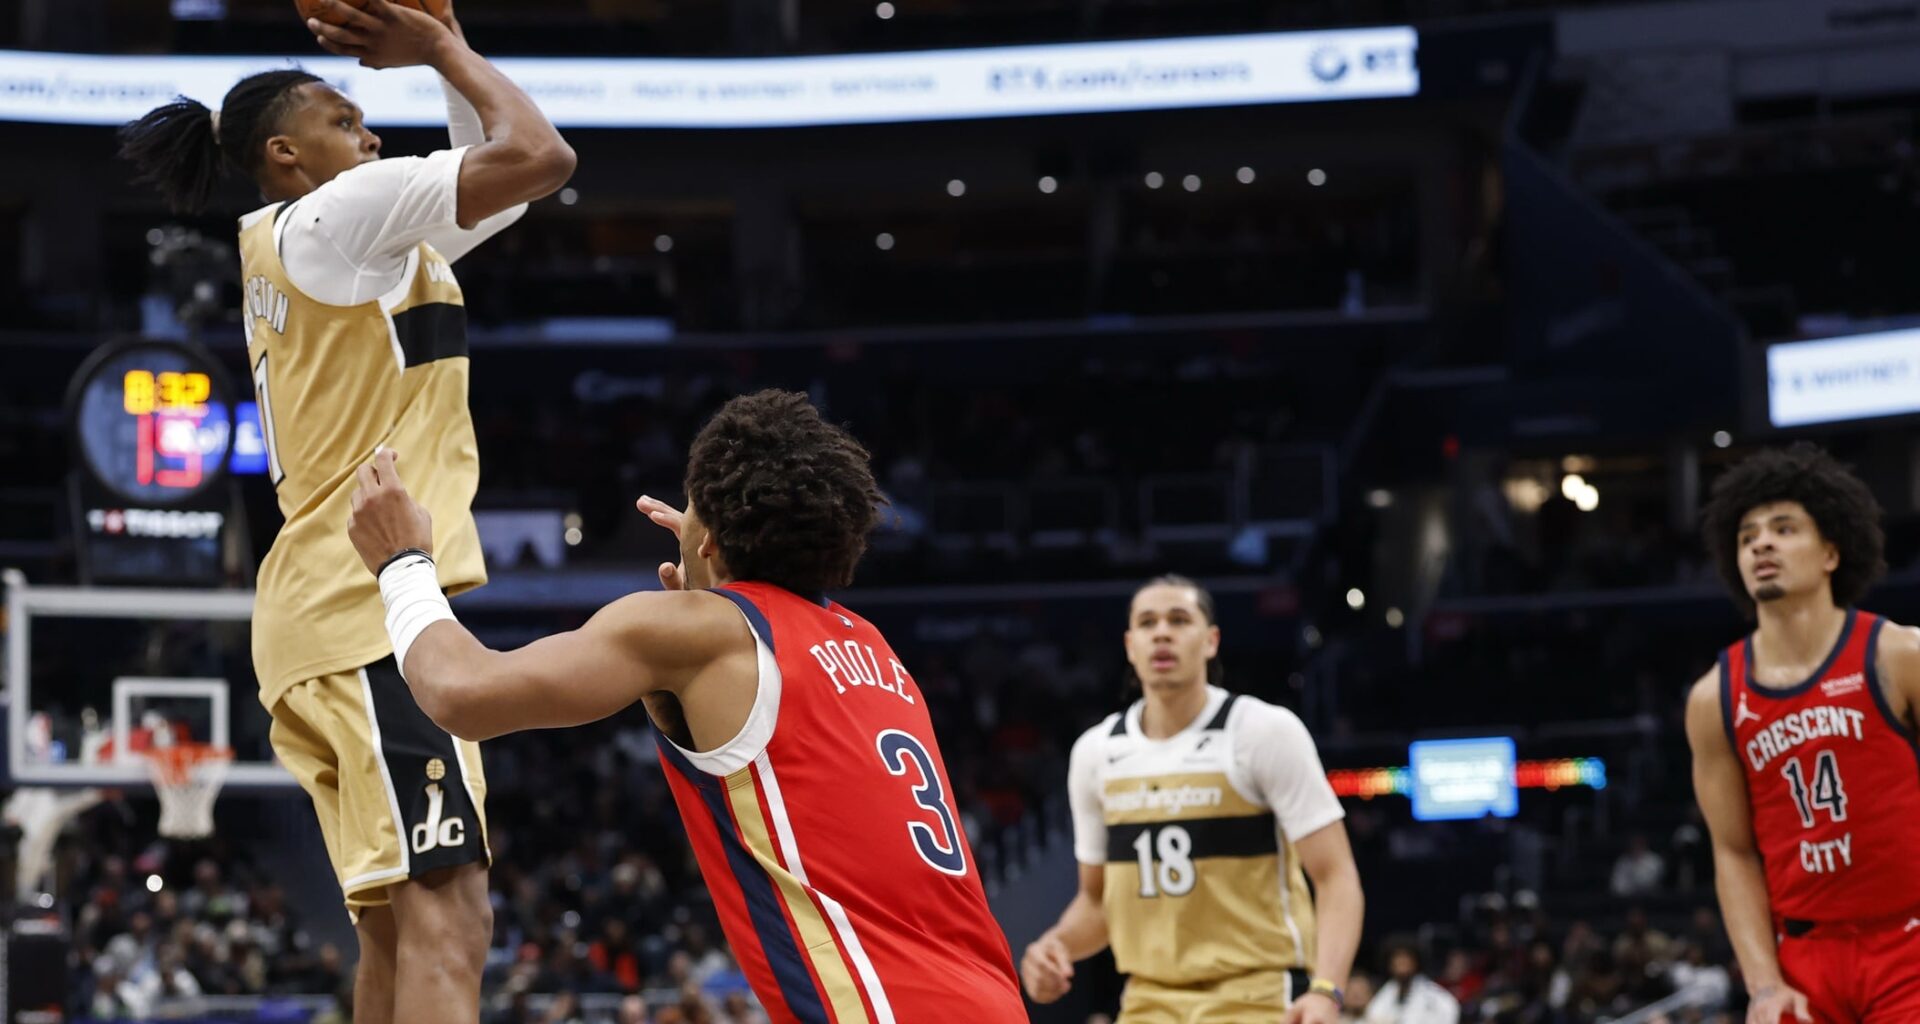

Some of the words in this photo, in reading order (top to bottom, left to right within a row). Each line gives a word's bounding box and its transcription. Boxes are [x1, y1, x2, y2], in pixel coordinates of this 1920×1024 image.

[809, 639, 915, 704] POOLE
[1746, 705, 1865, 772] CRESCENT
[876, 728, 968, 877] 3
[1781, 749, 1848, 829] 14
[1132, 824, 1197, 899] 18
[1800, 832, 1852, 874] CITY
